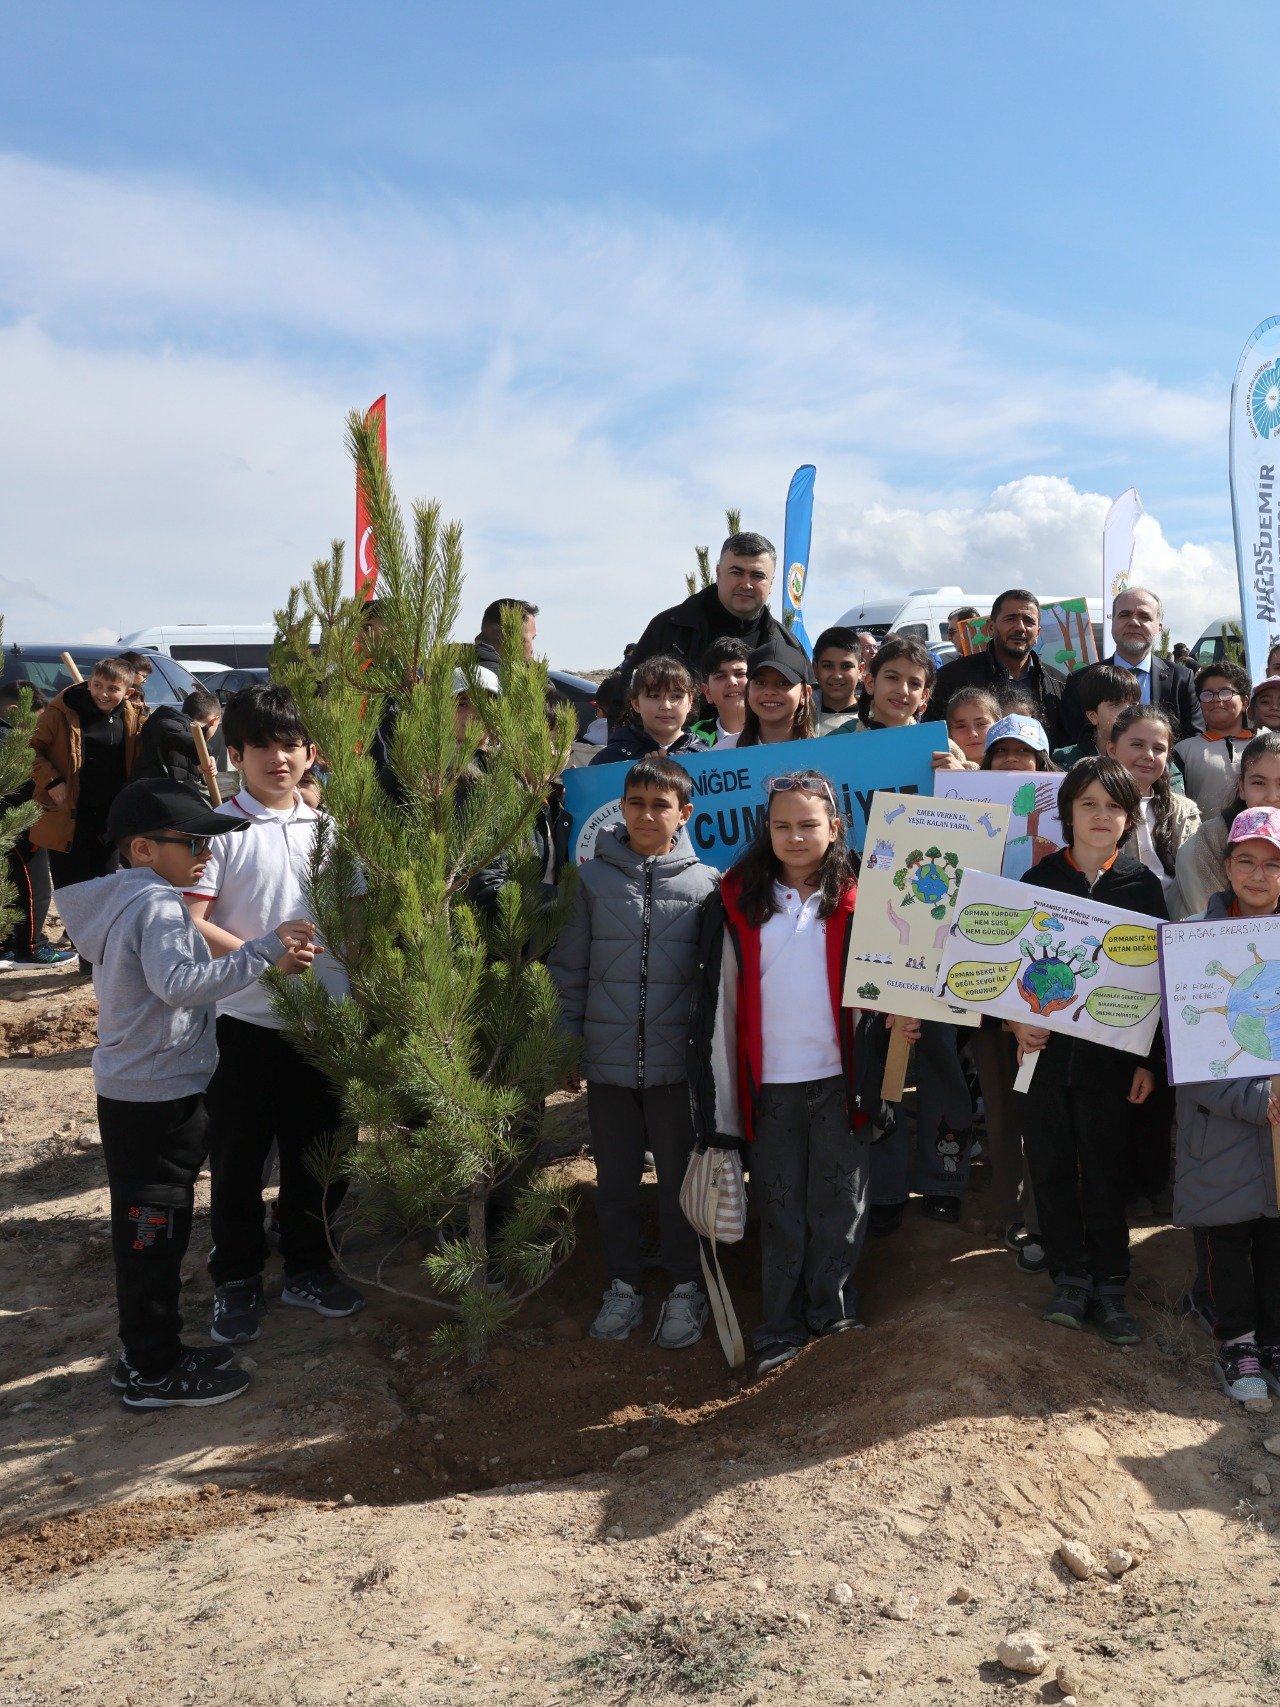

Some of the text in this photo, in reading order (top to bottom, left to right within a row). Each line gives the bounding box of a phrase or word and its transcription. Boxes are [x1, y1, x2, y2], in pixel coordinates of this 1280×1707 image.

[691, 768, 752, 797] NİĞDE
[916, 808, 936, 819] EMEK
[937, 811, 958, 821] VEREN
[581, 832, 594, 848] T.C.
[589, 807, 611, 831] MİLLİ
[927, 819, 949, 829] KALAN
[990, 910, 1019, 918] YURDUN
[1108, 935, 1145, 943] ORMANSIZ
[1108, 945, 1131, 953] VATAN
[950, 971, 975, 979] ORMAN
[886, 979, 919, 992] GELECEĞE
